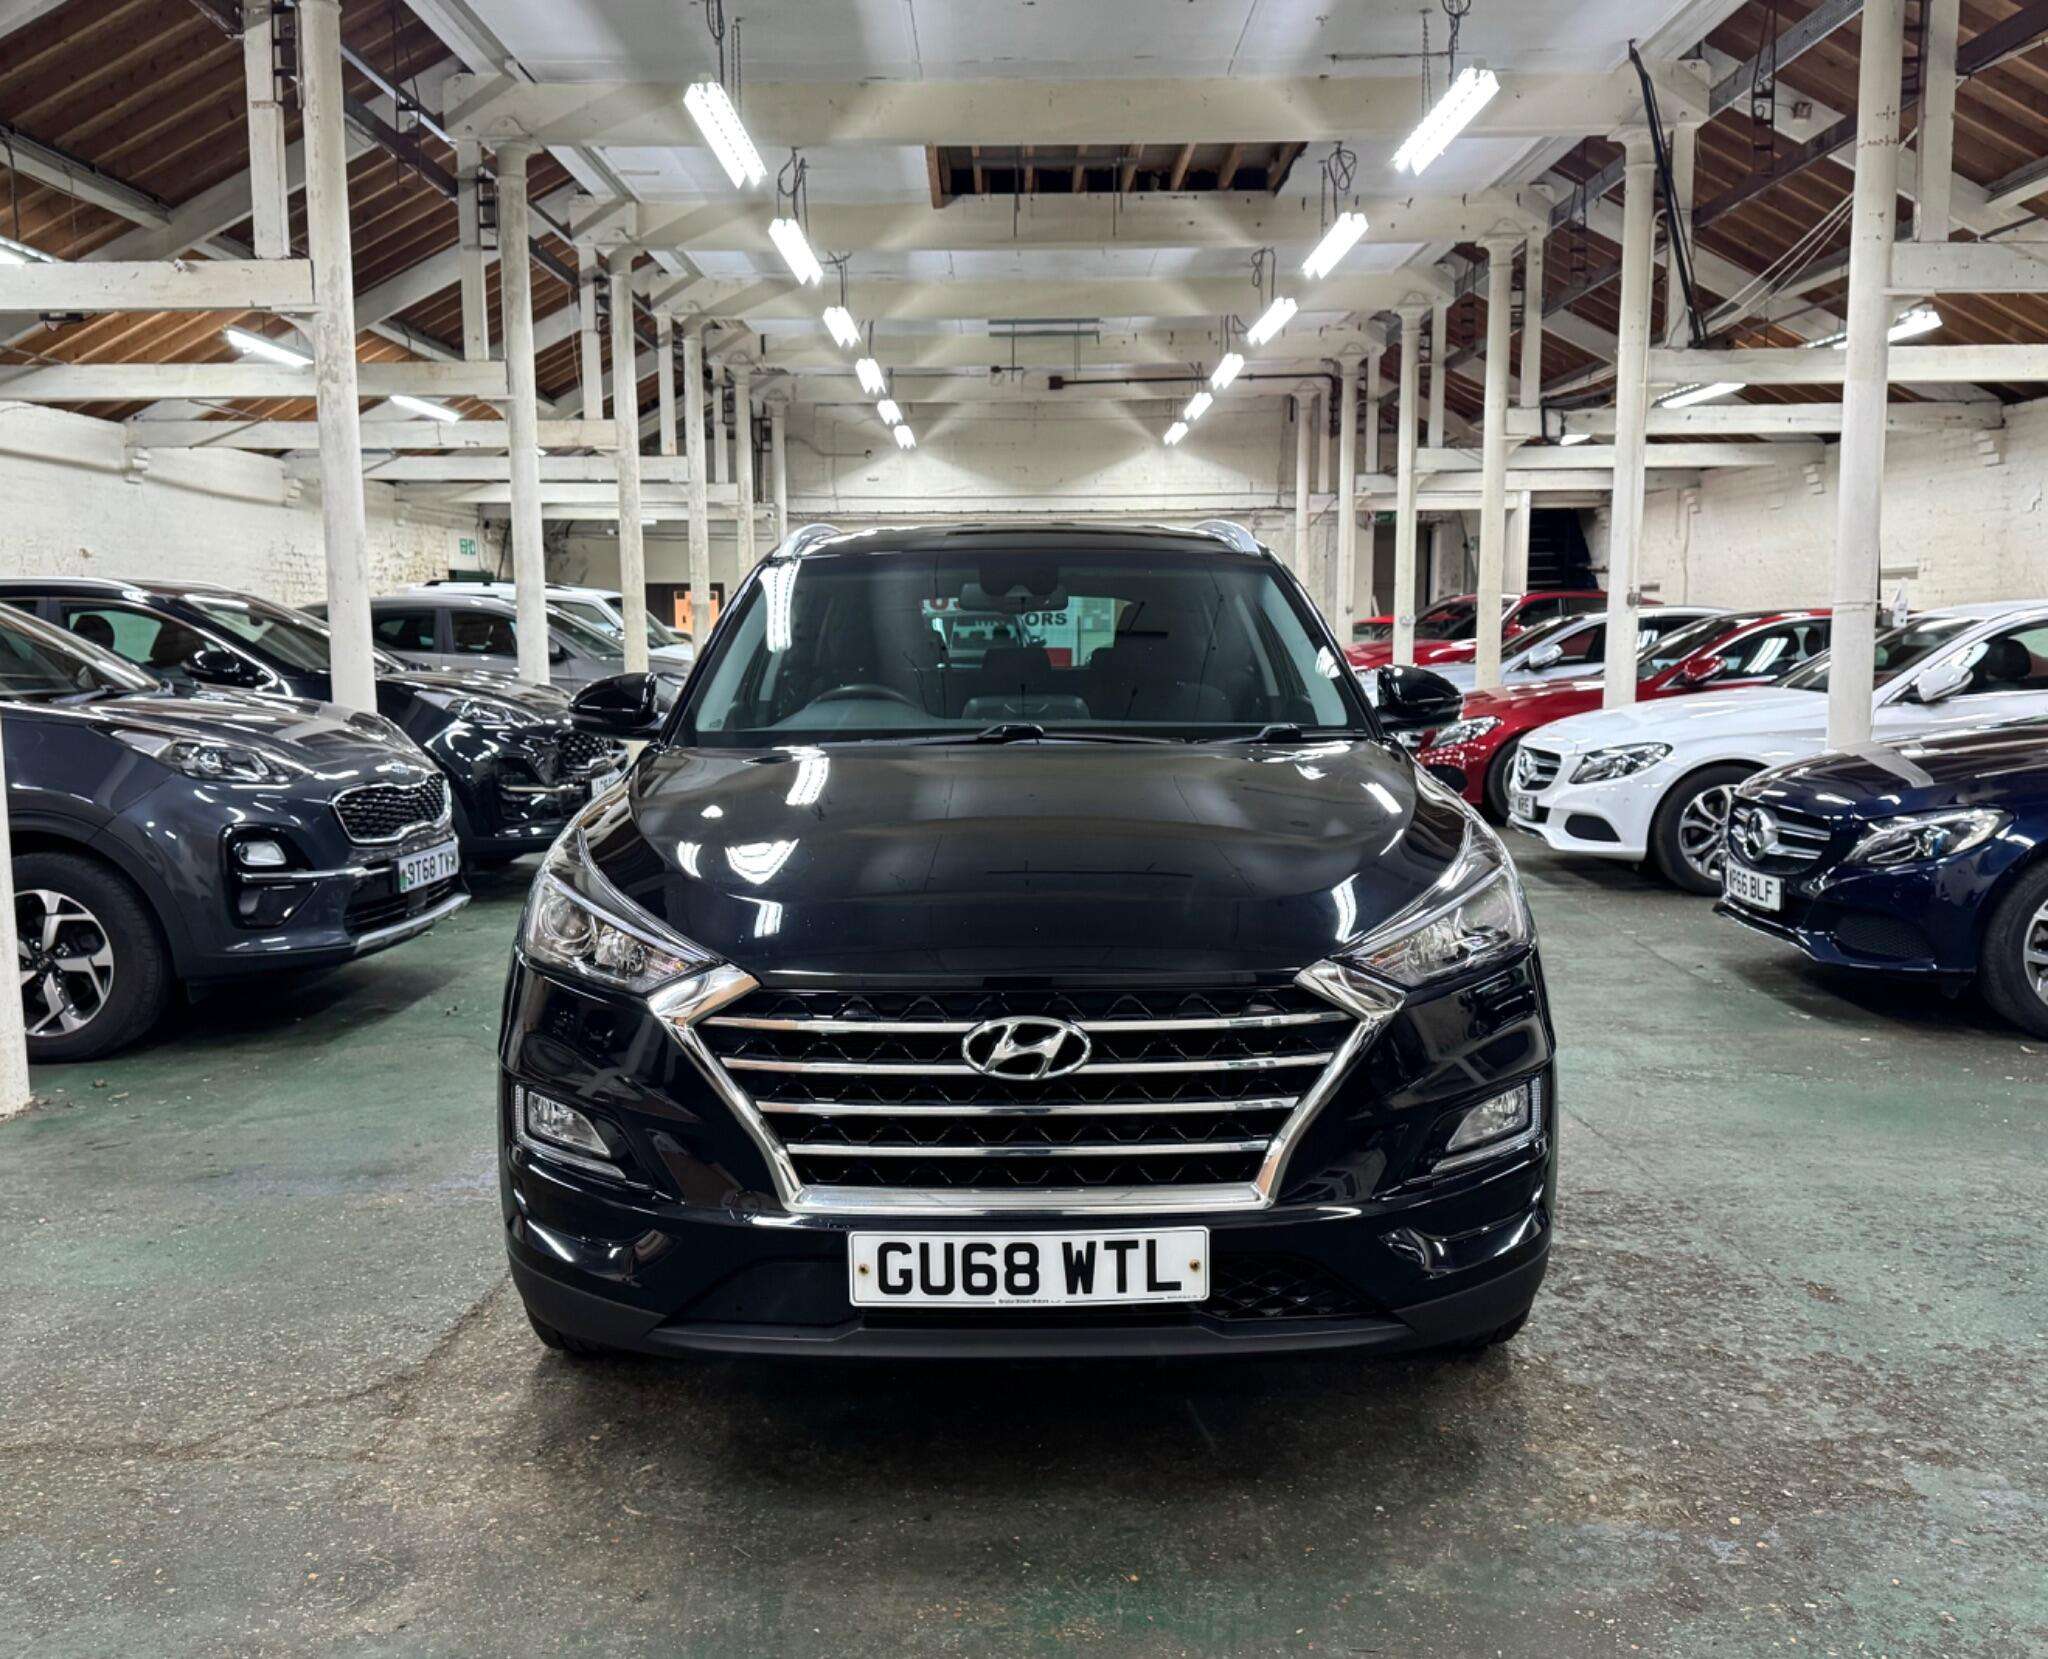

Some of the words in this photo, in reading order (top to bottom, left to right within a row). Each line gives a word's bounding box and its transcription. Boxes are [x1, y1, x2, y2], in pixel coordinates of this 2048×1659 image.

[1023, 611, 1068, 627] ORS
[1750, 875, 1774, 903] BLF
[876, 1241, 1040, 1296] GU68
[1062, 1239, 1183, 1295] WTL
